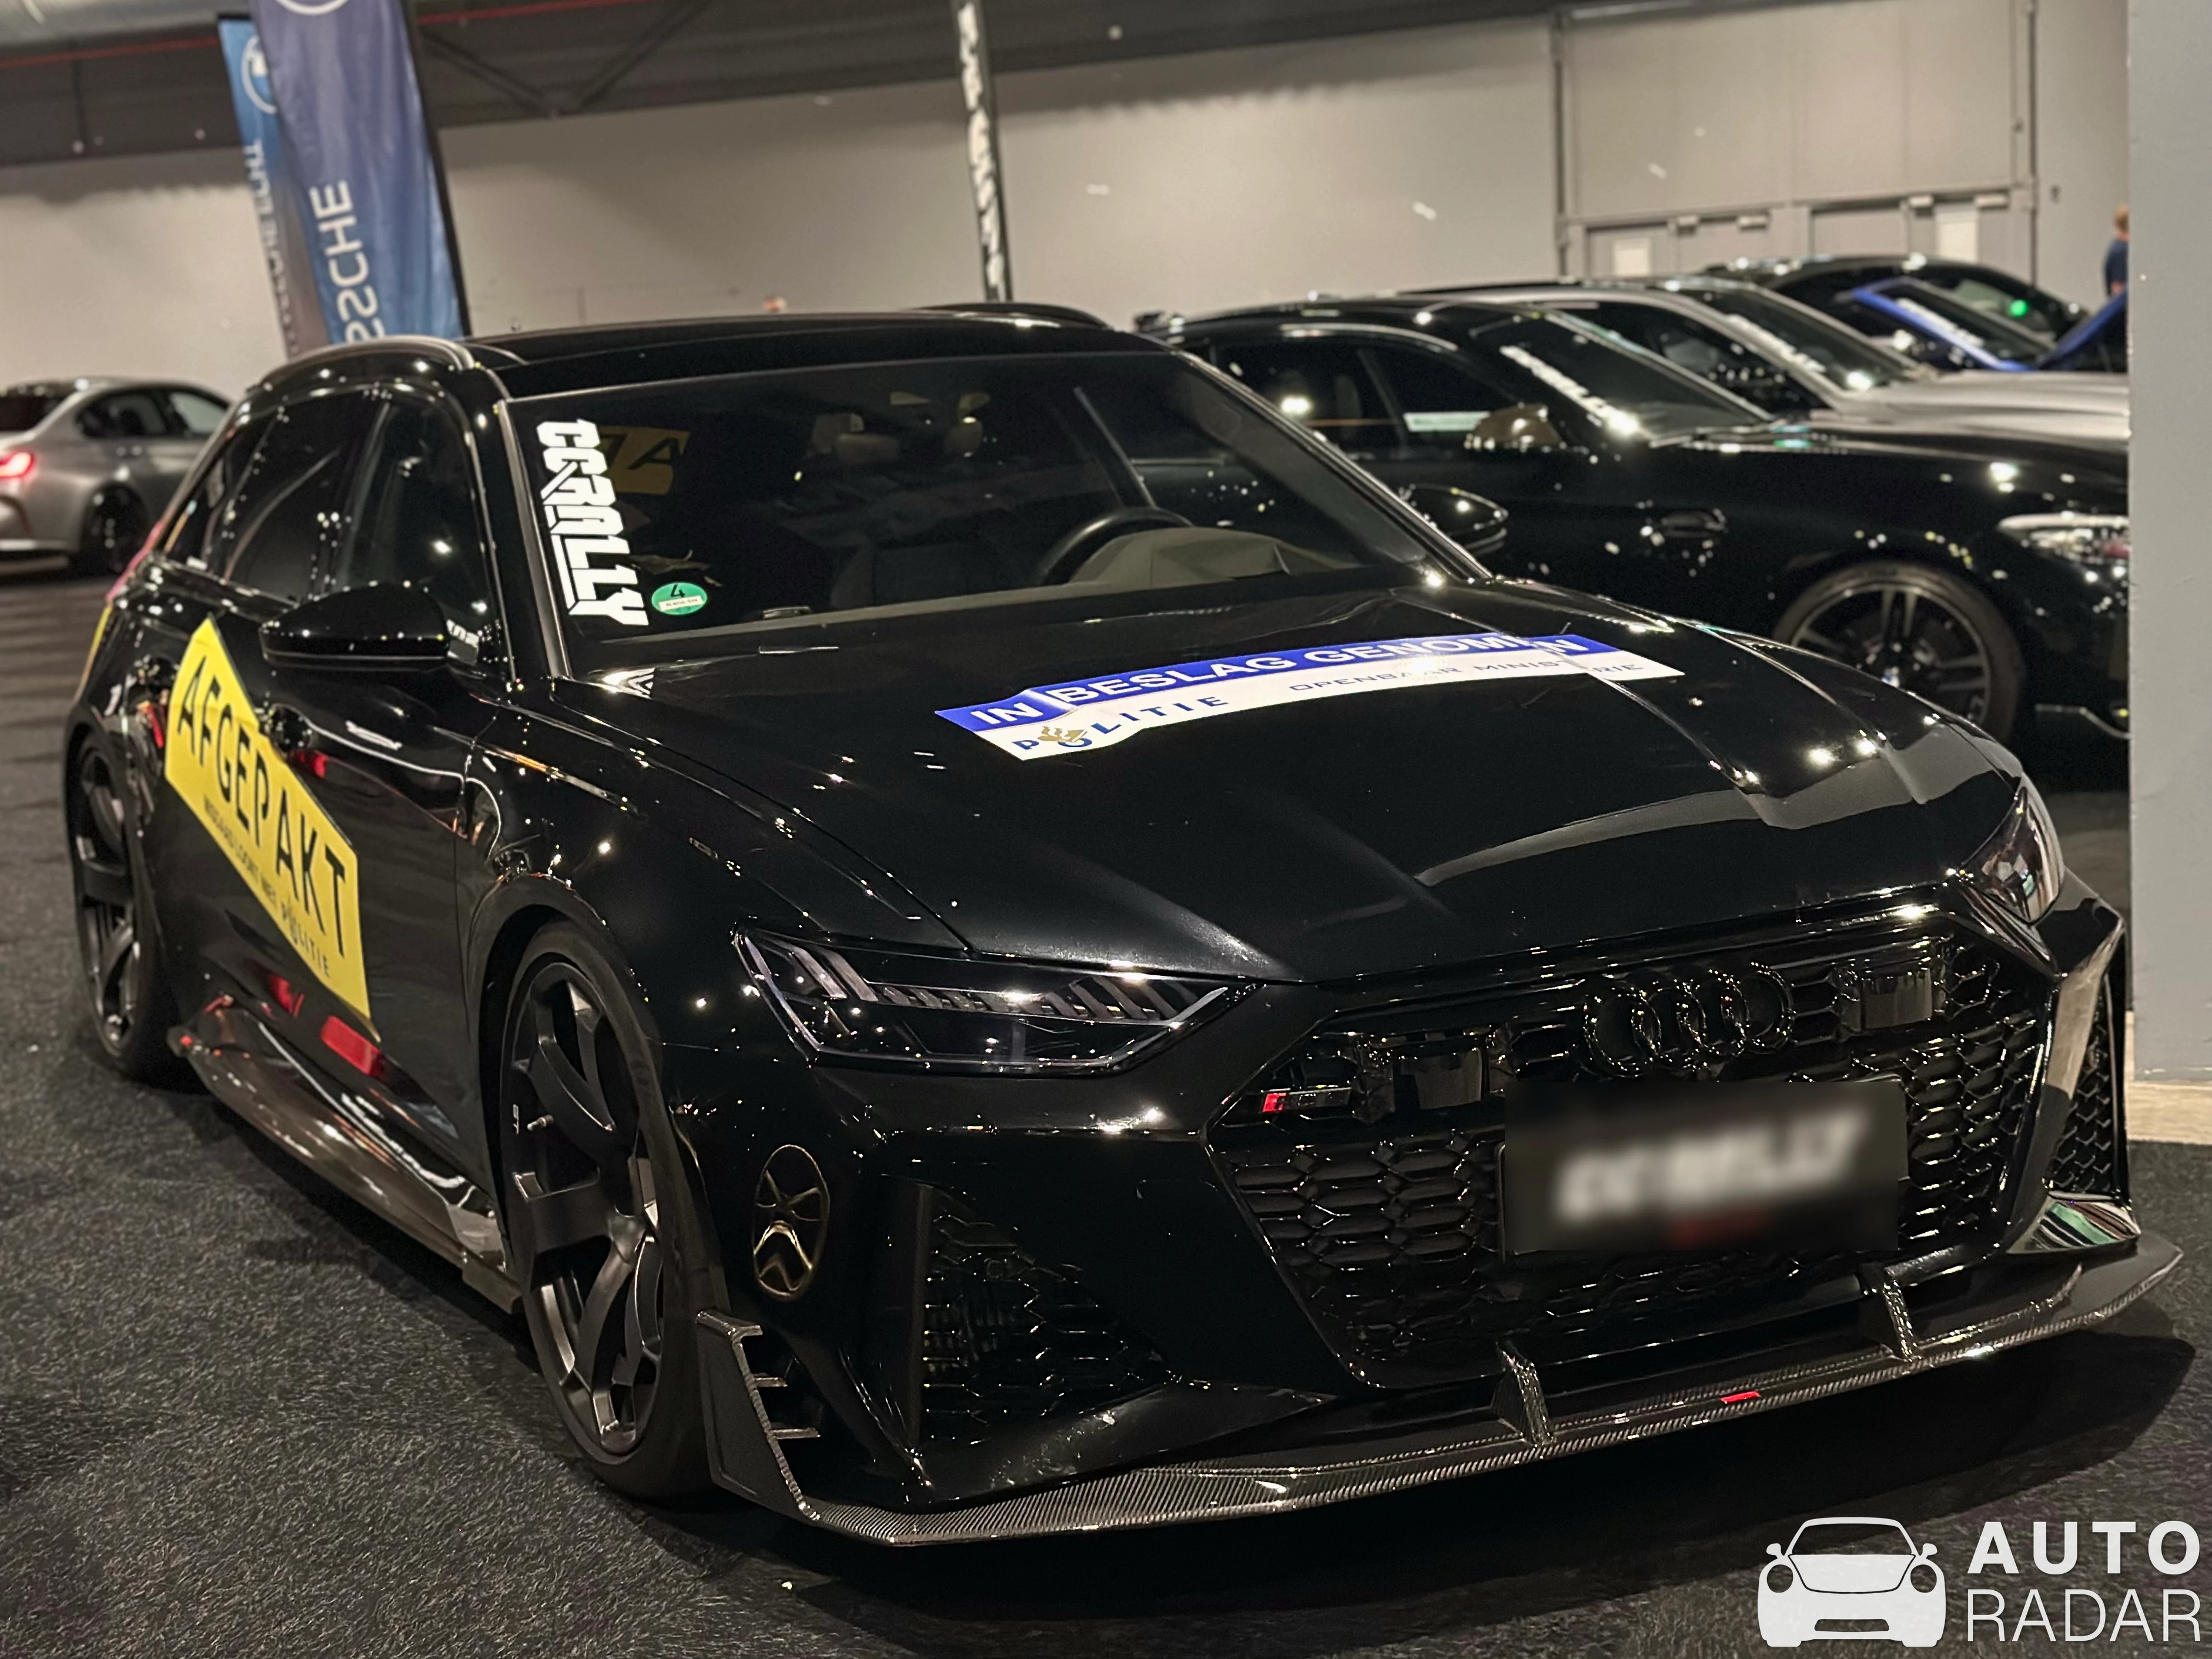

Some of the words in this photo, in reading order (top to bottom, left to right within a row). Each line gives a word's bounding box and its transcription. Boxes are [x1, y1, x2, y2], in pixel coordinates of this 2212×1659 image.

[670, 584, 686, 598] 4
[971, 701, 1044, 725] IN
[1046, 657, 1297, 703] BESLAG
[1473, 660, 1644, 673] MINISRIE
[1011, 697, 1229, 751] POLITIE
[177, 655, 346, 959] AFGEPAKT
